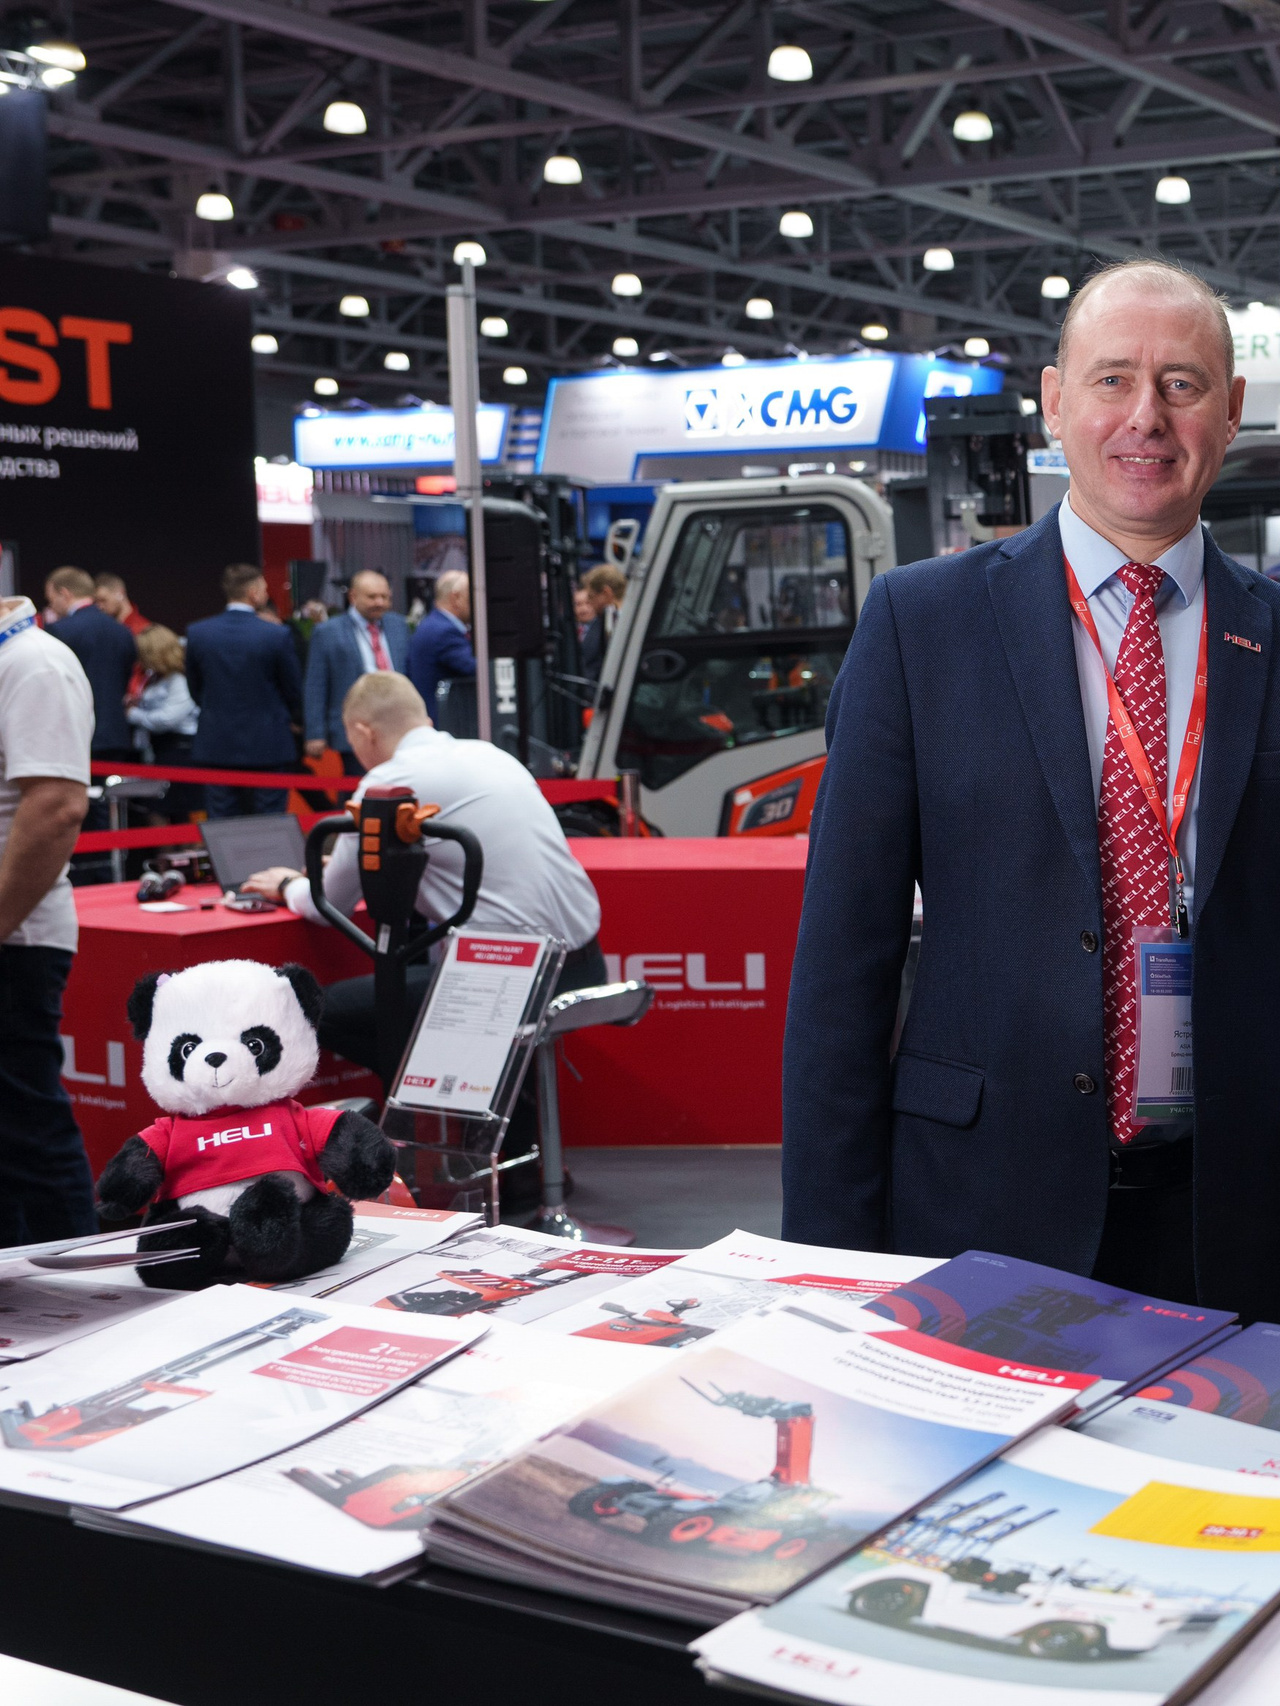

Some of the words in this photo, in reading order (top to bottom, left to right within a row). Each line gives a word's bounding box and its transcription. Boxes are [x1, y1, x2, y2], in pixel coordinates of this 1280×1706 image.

[733, 385, 858, 428] XCMG
[43, 425, 139, 451] решений
[1122, 569, 1150, 590] HELI
[1126, 613, 1150, 639] HELI
[1118, 637, 1142, 665] HELI
[1224, 632, 1261, 653] HELI
[1130, 653, 1155, 677] HELI
[1145, 673, 1165, 692] HEL
[1134, 691, 1160, 716] HELI
[1103, 762, 1130, 788] HELI
[1118, 784, 1142, 804] HEL
[1107, 802, 1134, 828] HELI
[1122, 819, 1149, 844] HELI
[1113, 843, 1140, 868] HELI
[1138, 835, 1163, 860] HELI
[1102, 867, 1129, 893] HELI
[1128, 859, 1155, 884] HELI
[1116, 883, 1144, 909] HELI
[1143, 875, 1168, 900] HELI
[1107, 908, 1134, 934] HELI
[1132, 899, 1158, 925] HELI
[658, 1000, 706, 1010] Logistics
[710, 1000, 765, 1010] Intelligent
[1116, 998, 1136, 1018] HEL
[1104, 1017, 1132, 1044] HELI
[197, 1122, 273, 1152] HELI
[393, 1211, 440, 1219] HELI
[1141, 1304, 1205, 1322] HELI
[998, 1365, 1065, 1384] HELI
[772, 1646, 860, 1678] HELI
